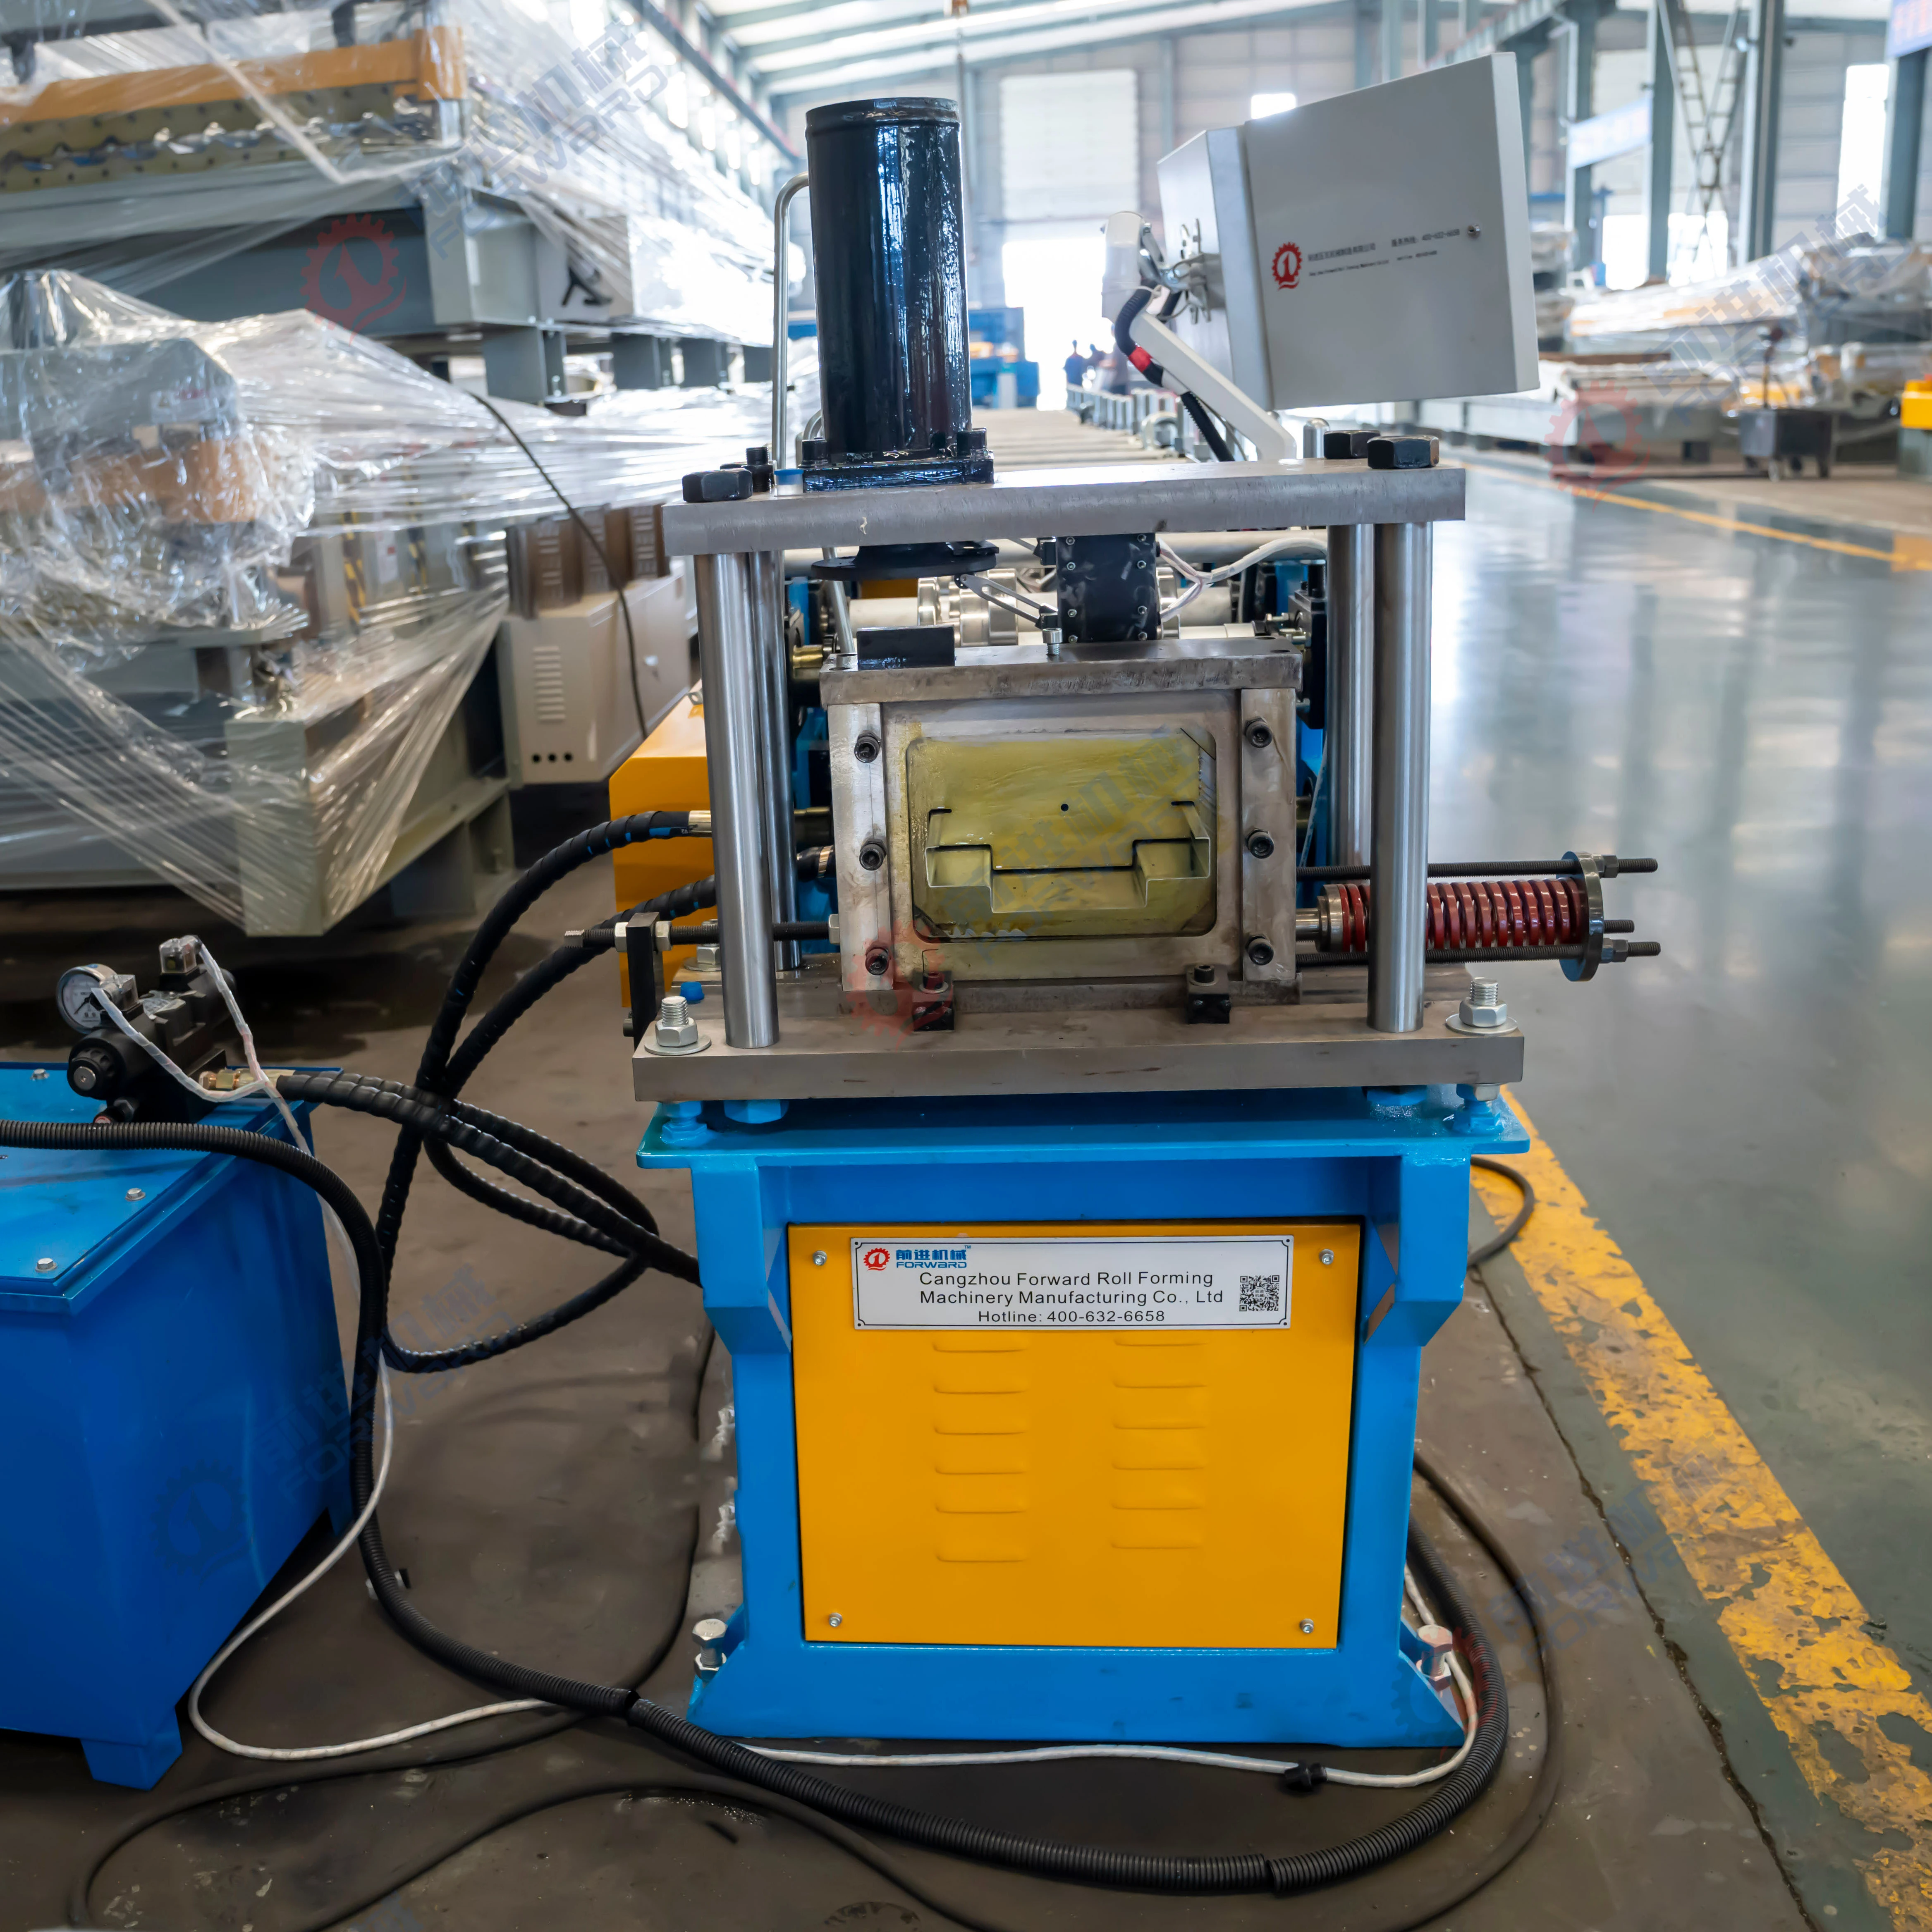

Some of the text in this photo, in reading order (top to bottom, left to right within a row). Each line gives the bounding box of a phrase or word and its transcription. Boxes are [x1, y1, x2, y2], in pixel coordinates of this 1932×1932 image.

[896, 1249, 967, 1260] 前进机械
[920, 1271, 1212, 1288] Cangzhou Forward Roll Forming
[921, 1290, 1222, 1307] Machinery Manufacturing Co., Ltd
[979, 1310, 1164, 1322] Hotline: 400-632-6658
